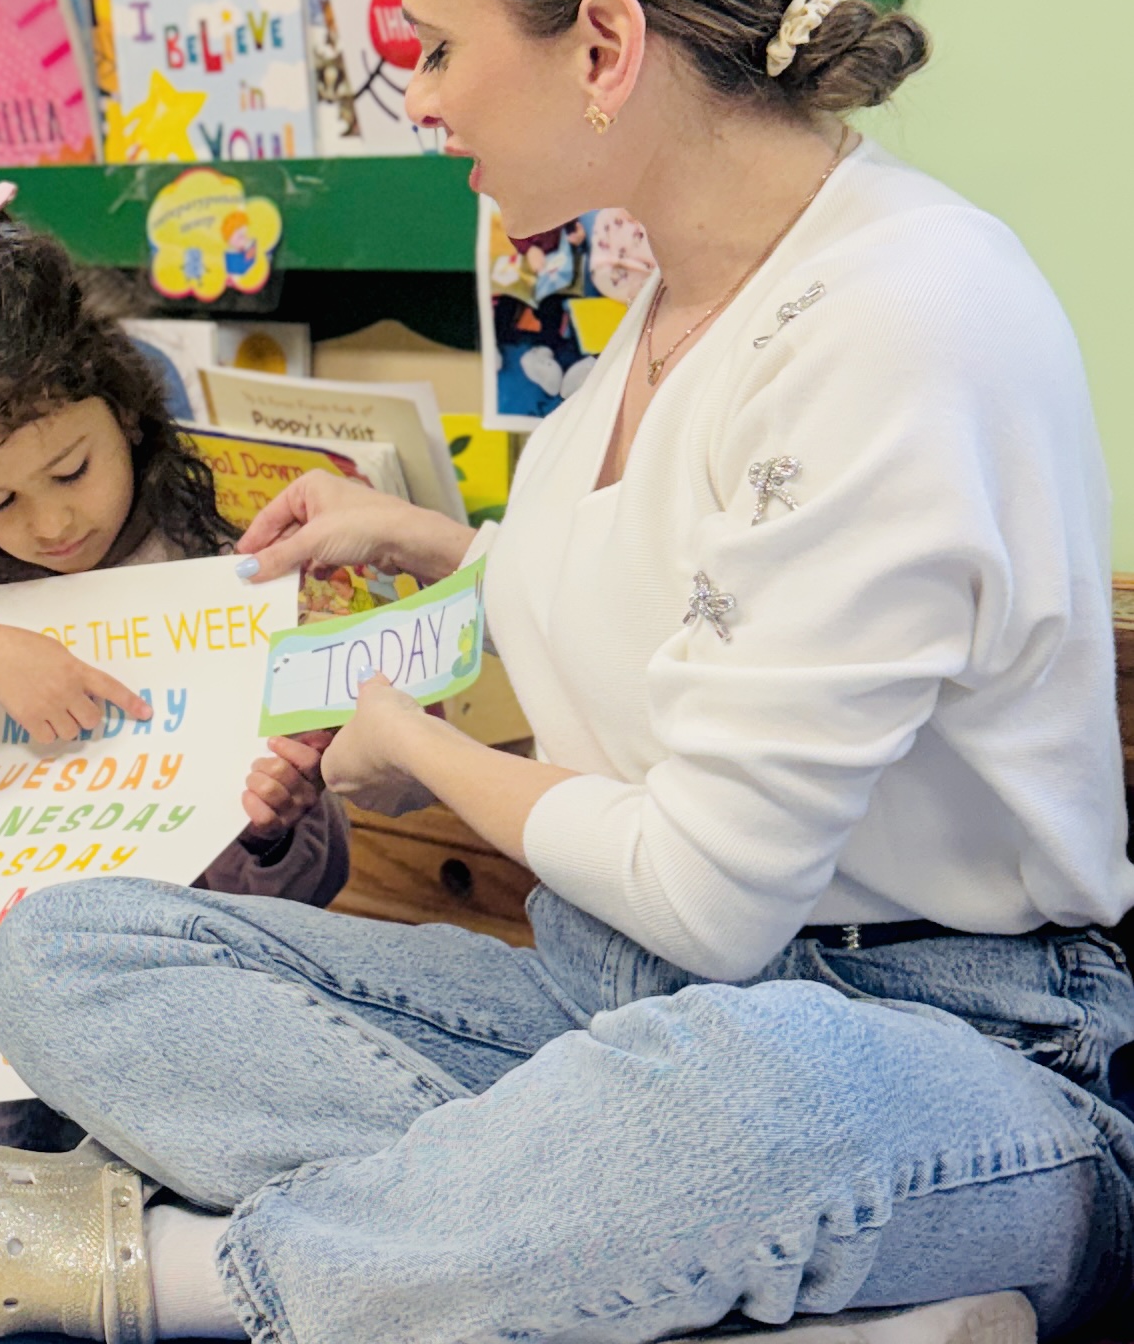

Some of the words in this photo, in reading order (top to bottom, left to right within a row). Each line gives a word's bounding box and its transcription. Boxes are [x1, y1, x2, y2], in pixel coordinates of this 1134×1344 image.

[129, 1, 155, 43] I
[239, 79, 266, 112] in
[328, 421, 375, 442] Visit
[87, 616, 152, 662] THE
[164, 601, 271, 655] WEEK
[312, 605, 448, 707] TODAY
